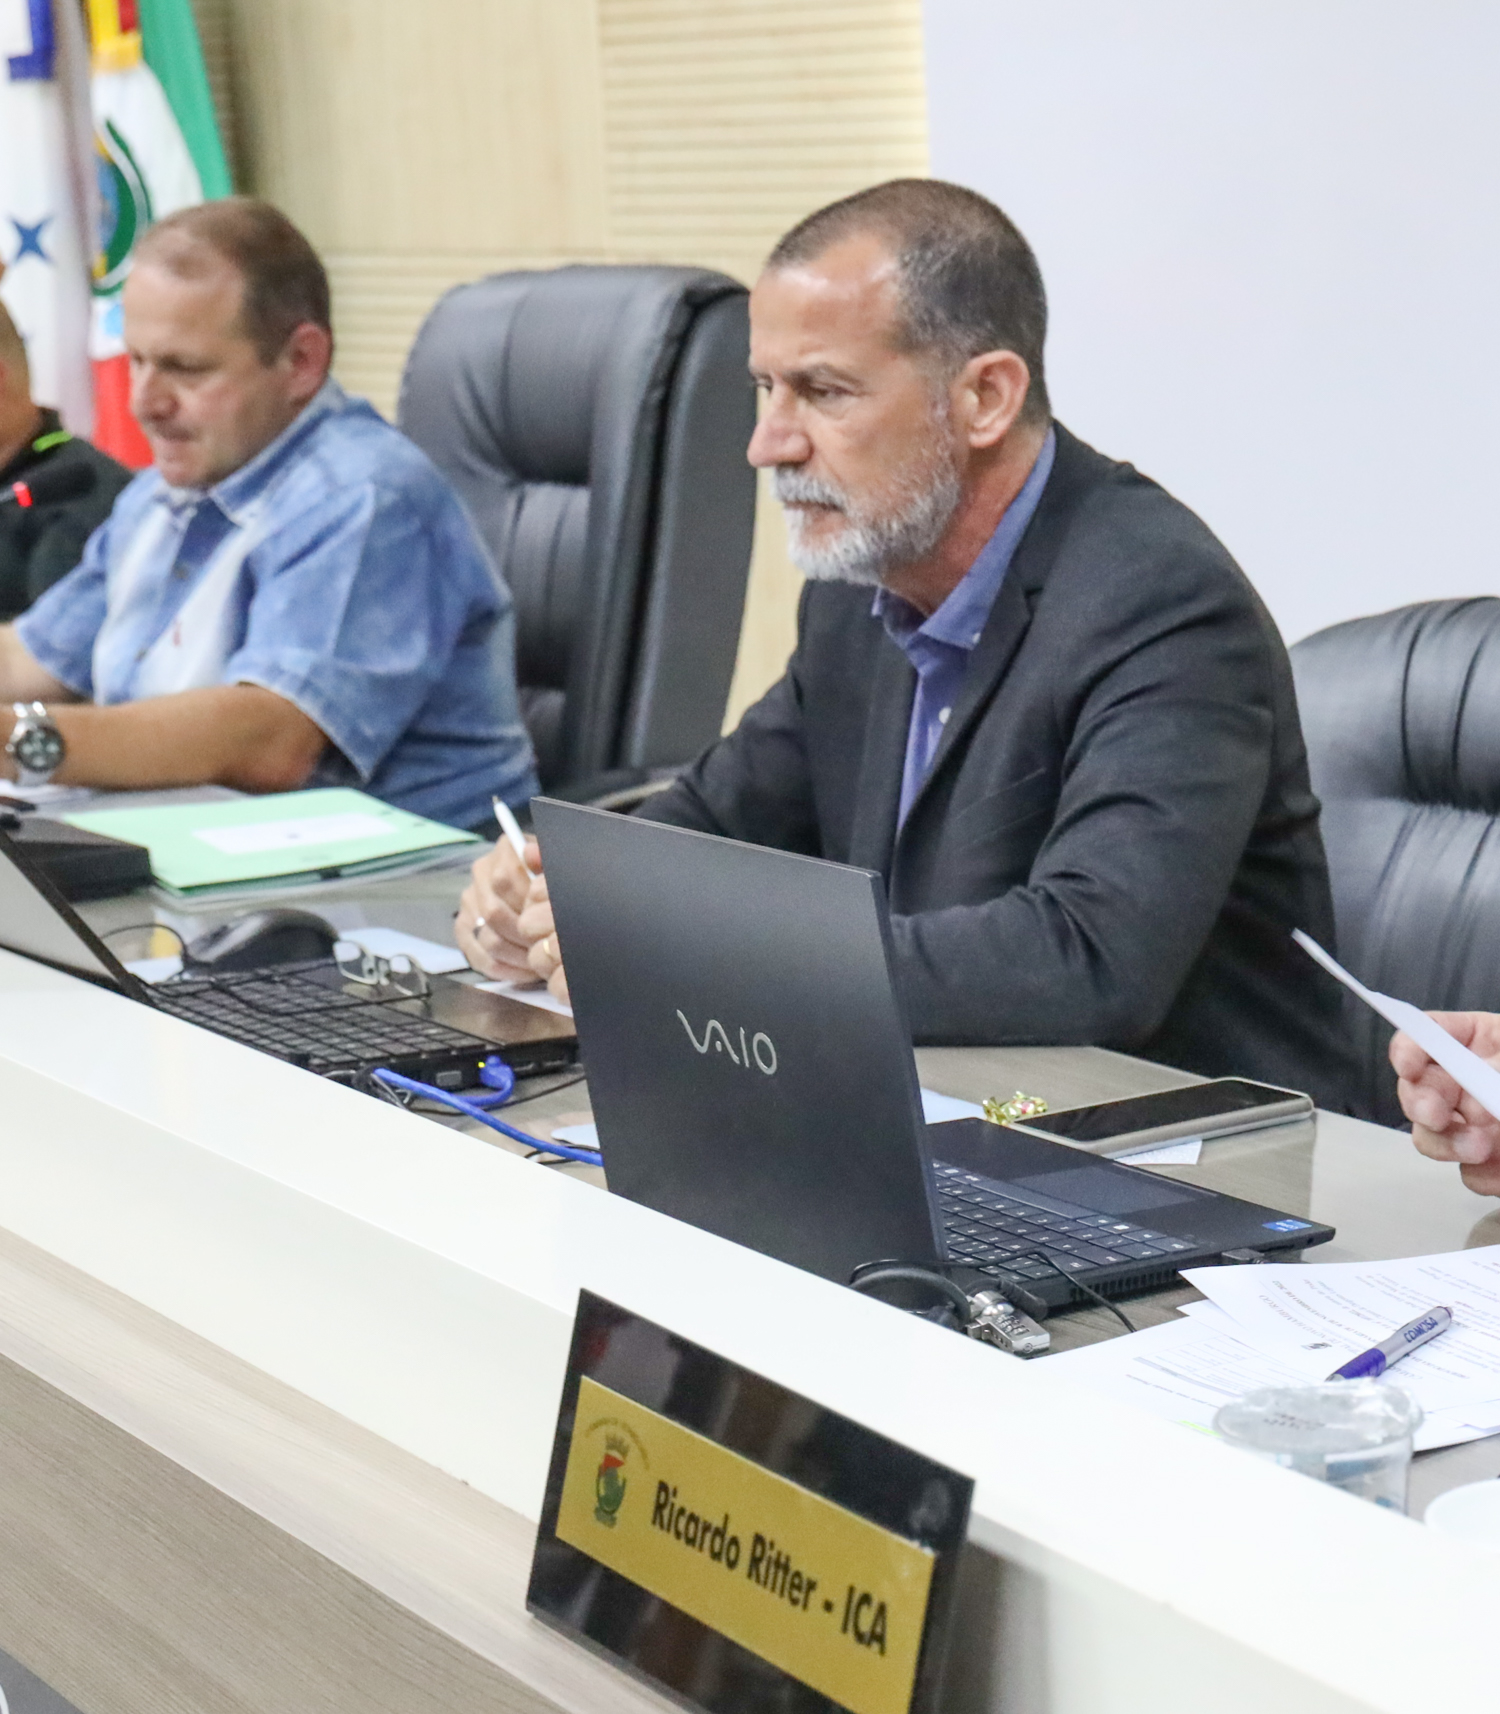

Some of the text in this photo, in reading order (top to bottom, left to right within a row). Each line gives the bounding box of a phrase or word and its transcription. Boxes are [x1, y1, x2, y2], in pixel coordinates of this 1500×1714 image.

[676, 1009, 777, 1075] VAIO
[652, 1480, 888, 1657] Ricardo Ritter - ICA
